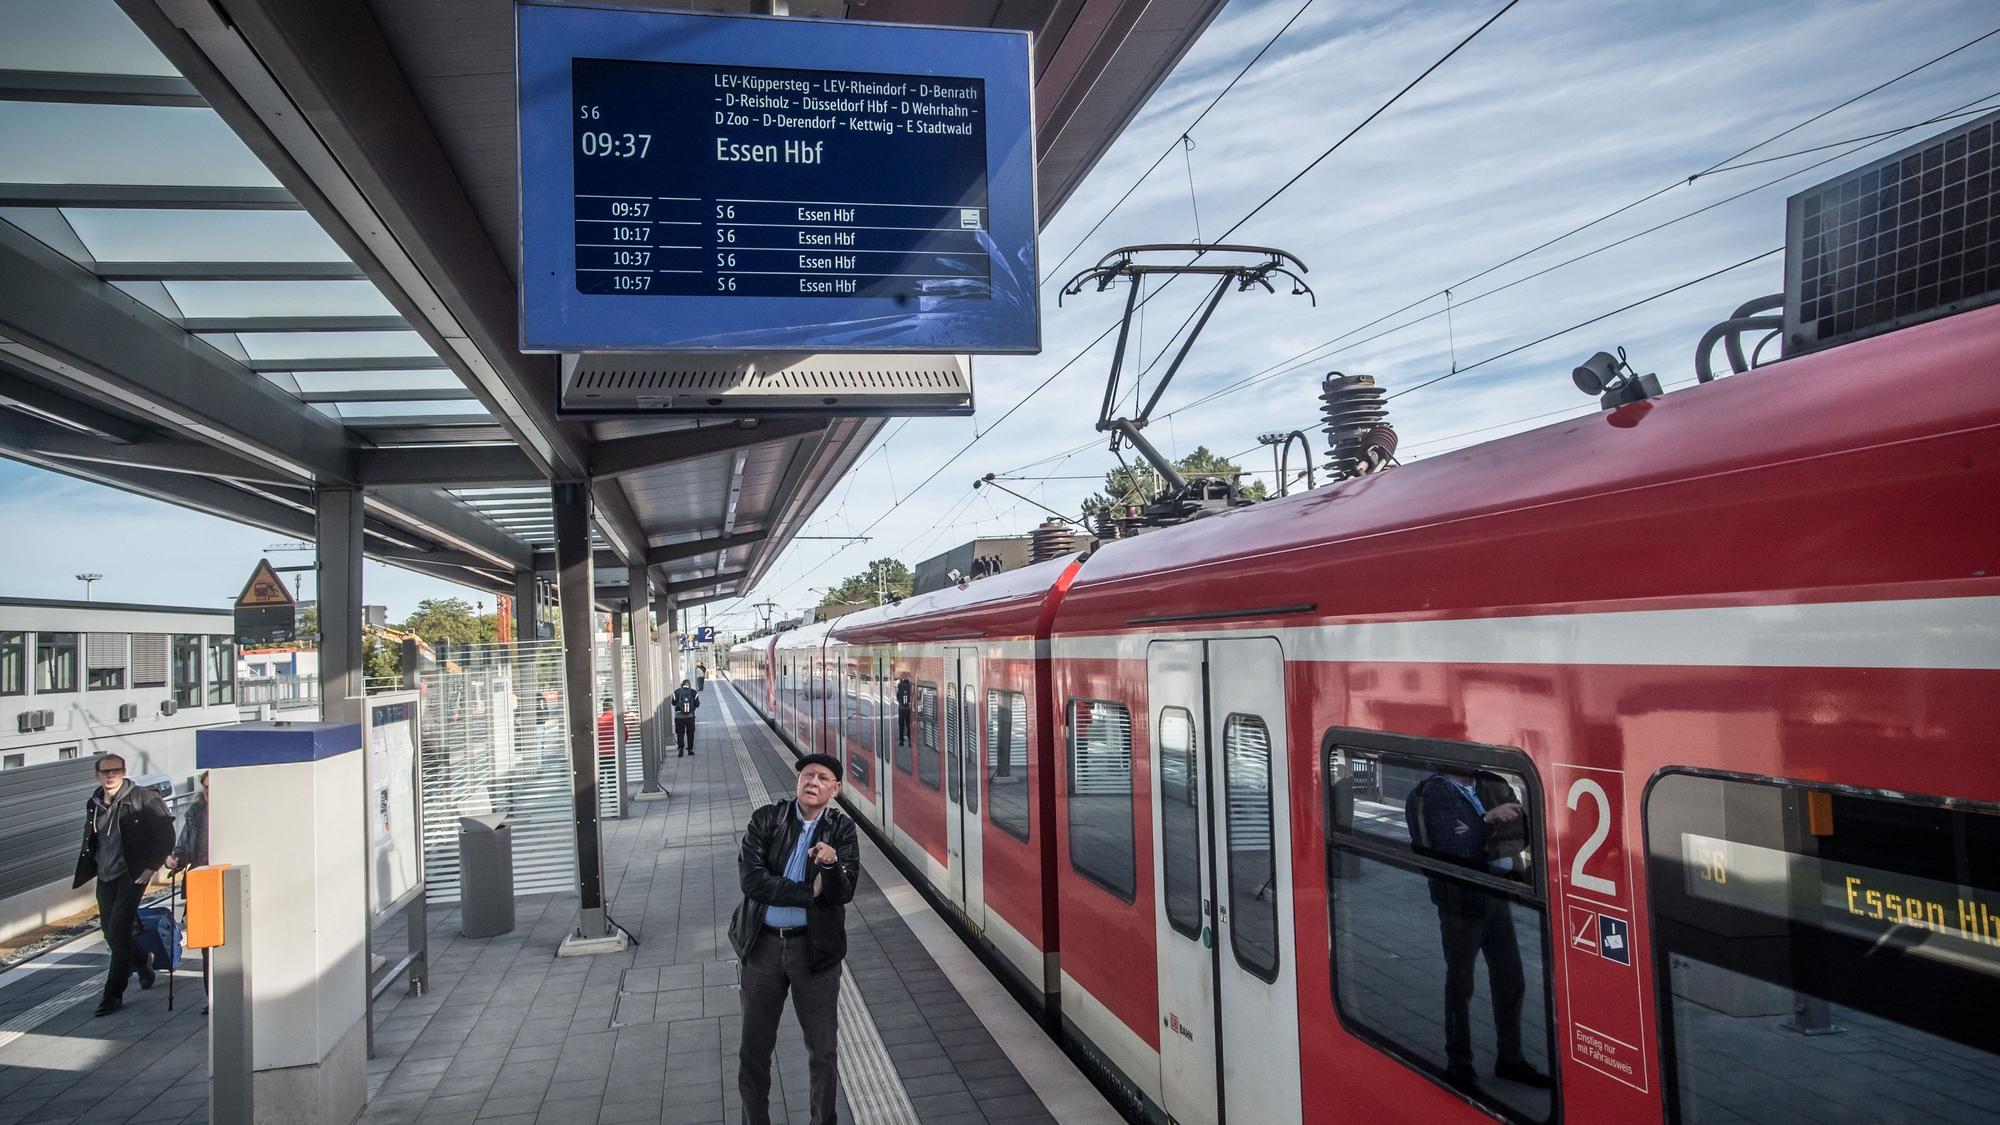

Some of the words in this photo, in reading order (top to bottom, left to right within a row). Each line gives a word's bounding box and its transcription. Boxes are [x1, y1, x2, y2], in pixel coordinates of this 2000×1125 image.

[714, 74, 810, 95] LEV-Küppersteg
[823, 79, 907, 96] LEV-Rheindorf
[920, 84, 977, 99] D-Benrath
[726, 93, 789, 109] D-Reisholz
[803, 96, 865, 112] Düsseldorf
[867, 99, 888, 114] Hbf
[901, 101, 910, 114] D
[912, 102, 969, 117] Wehrhahn
[715, 111, 724, 125] D
[726, 111, 749, 126] Zoo
[763, 113, 836, 129] D-Derendorf
[849, 117, 894, 135] Kettwig
[906, 119, 914, 133] E
[916, 120, 972, 135] Stadtwald
[582, 131, 652, 159] 09:37
[717, 137, 778, 163] Essen
[784, 139, 824, 164] Hbf
[612, 202, 650, 217] 09:57
[798, 207, 831, 222] Essen
[833, 208, 855, 222] Hbf
[613, 227, 650, 242] 10:17
[798, 231, 832, 245] Essen
[834, 232, 856, 246] Hbf
[613, 251, 651, 266] 10:37
[799, 254, 832, 269] Essen
[834, 255, 856, 269] Hbf
[614, 276, 651, 290] 10:57
[799, 278, 832, 293] Essen
[835, 279, 857, 293] Hbf
[704, 628, 713, 640] 2
[1566, 778, 1617, 897] 2
[1845, 876, 1946, 935] Essen
[1179, 1023, 1194, 1042] BAHN
[1576, 1029, 1603, 1051] Einstieg
[1604, 1043, 1616, 1055] nur
[1577, 1043, 1589, 1056] mit
[1589, 1047, 1633, 1075] Fahrausweis
